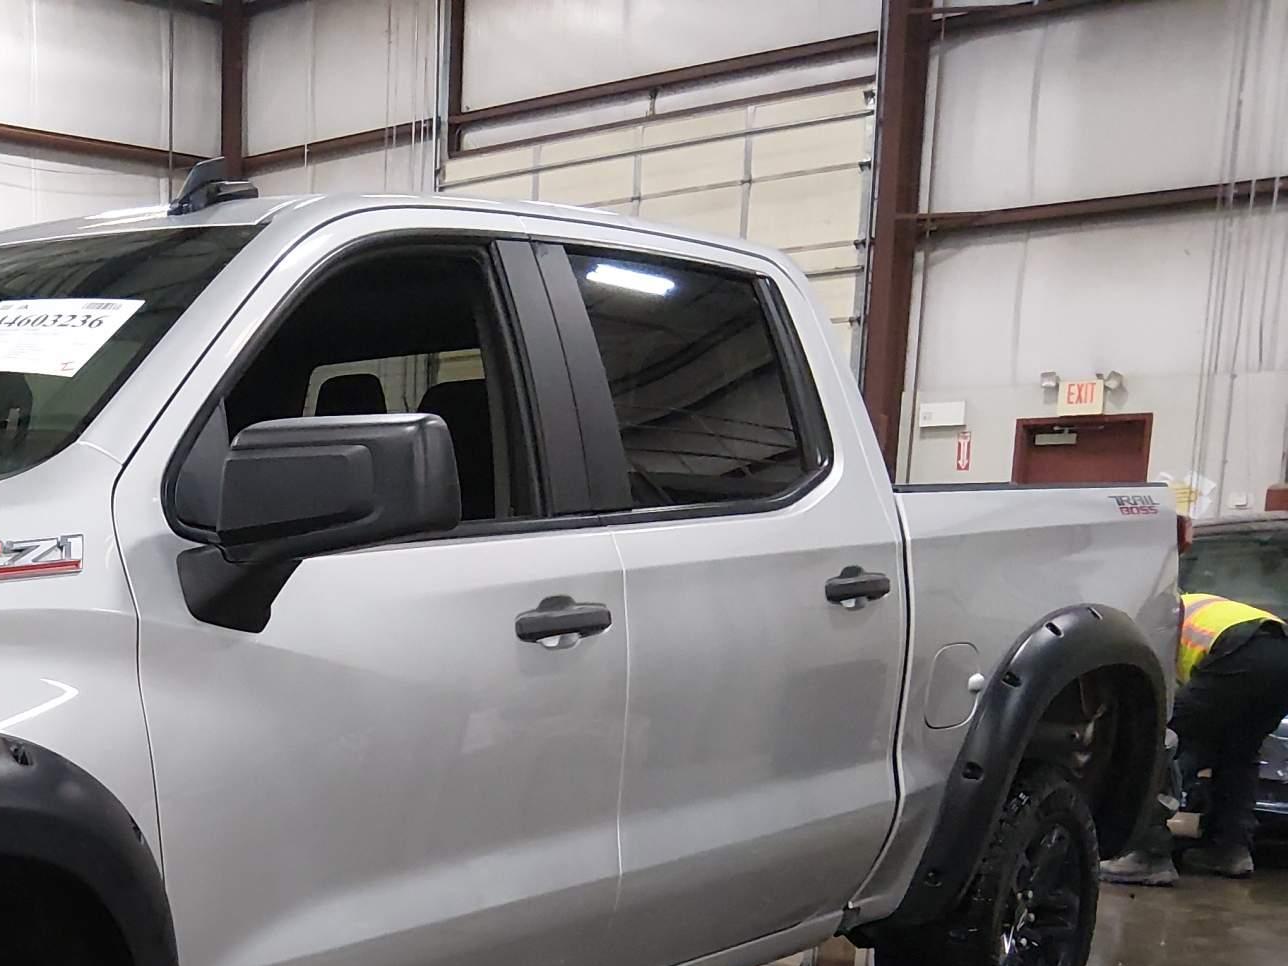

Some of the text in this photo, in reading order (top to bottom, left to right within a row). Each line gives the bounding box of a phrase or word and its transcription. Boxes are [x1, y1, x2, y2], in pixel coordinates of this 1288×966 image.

[1066, 382, 1097, 405] EXIT
[1107, 495, 1160, 507] TRAIL
[1119, 505, 1160, 516] BOSS
